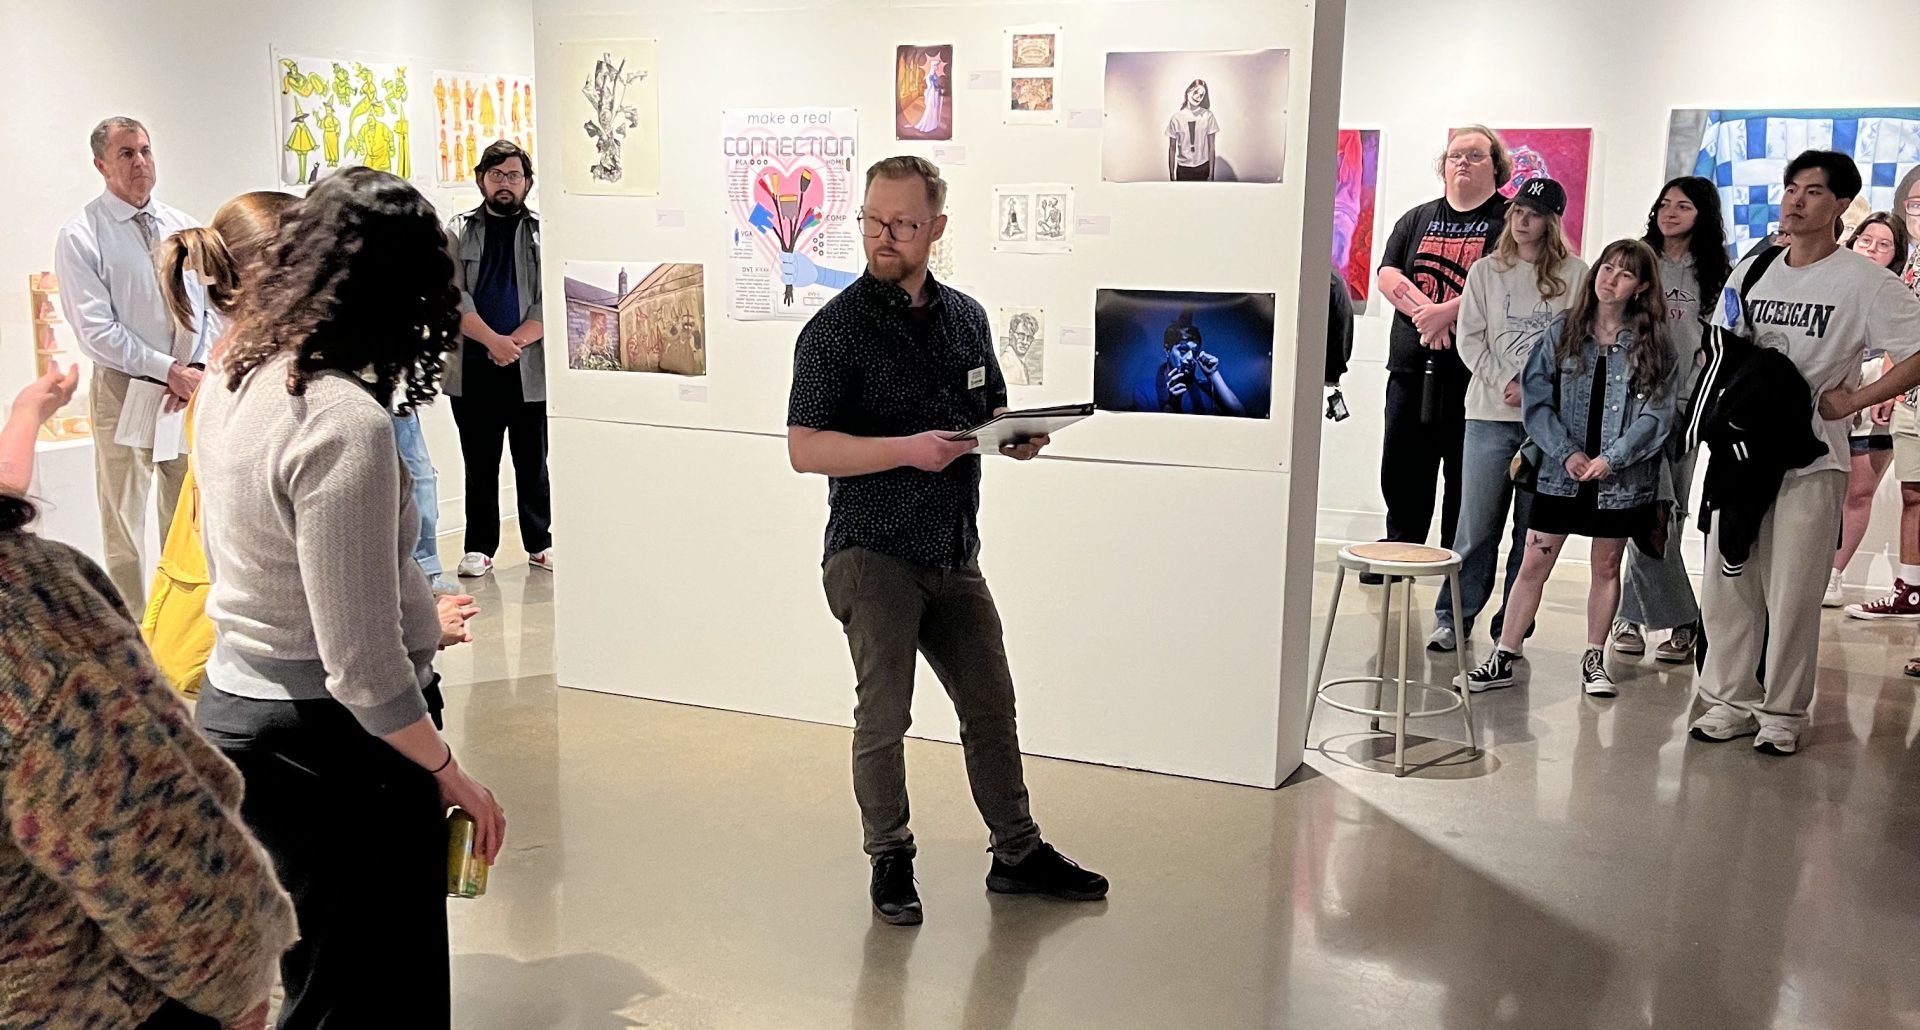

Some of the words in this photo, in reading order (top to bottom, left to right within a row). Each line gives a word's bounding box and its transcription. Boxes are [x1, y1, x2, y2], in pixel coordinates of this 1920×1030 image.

[747, 112, 785, 125] make
[790, 113, 799, 124] a
[803, 111, 831, 124] real
[723, 136, 855, 157] CONNECTION
[1527, 181, 1544, 196] NY
[826, 214, 847, 222] COMP
